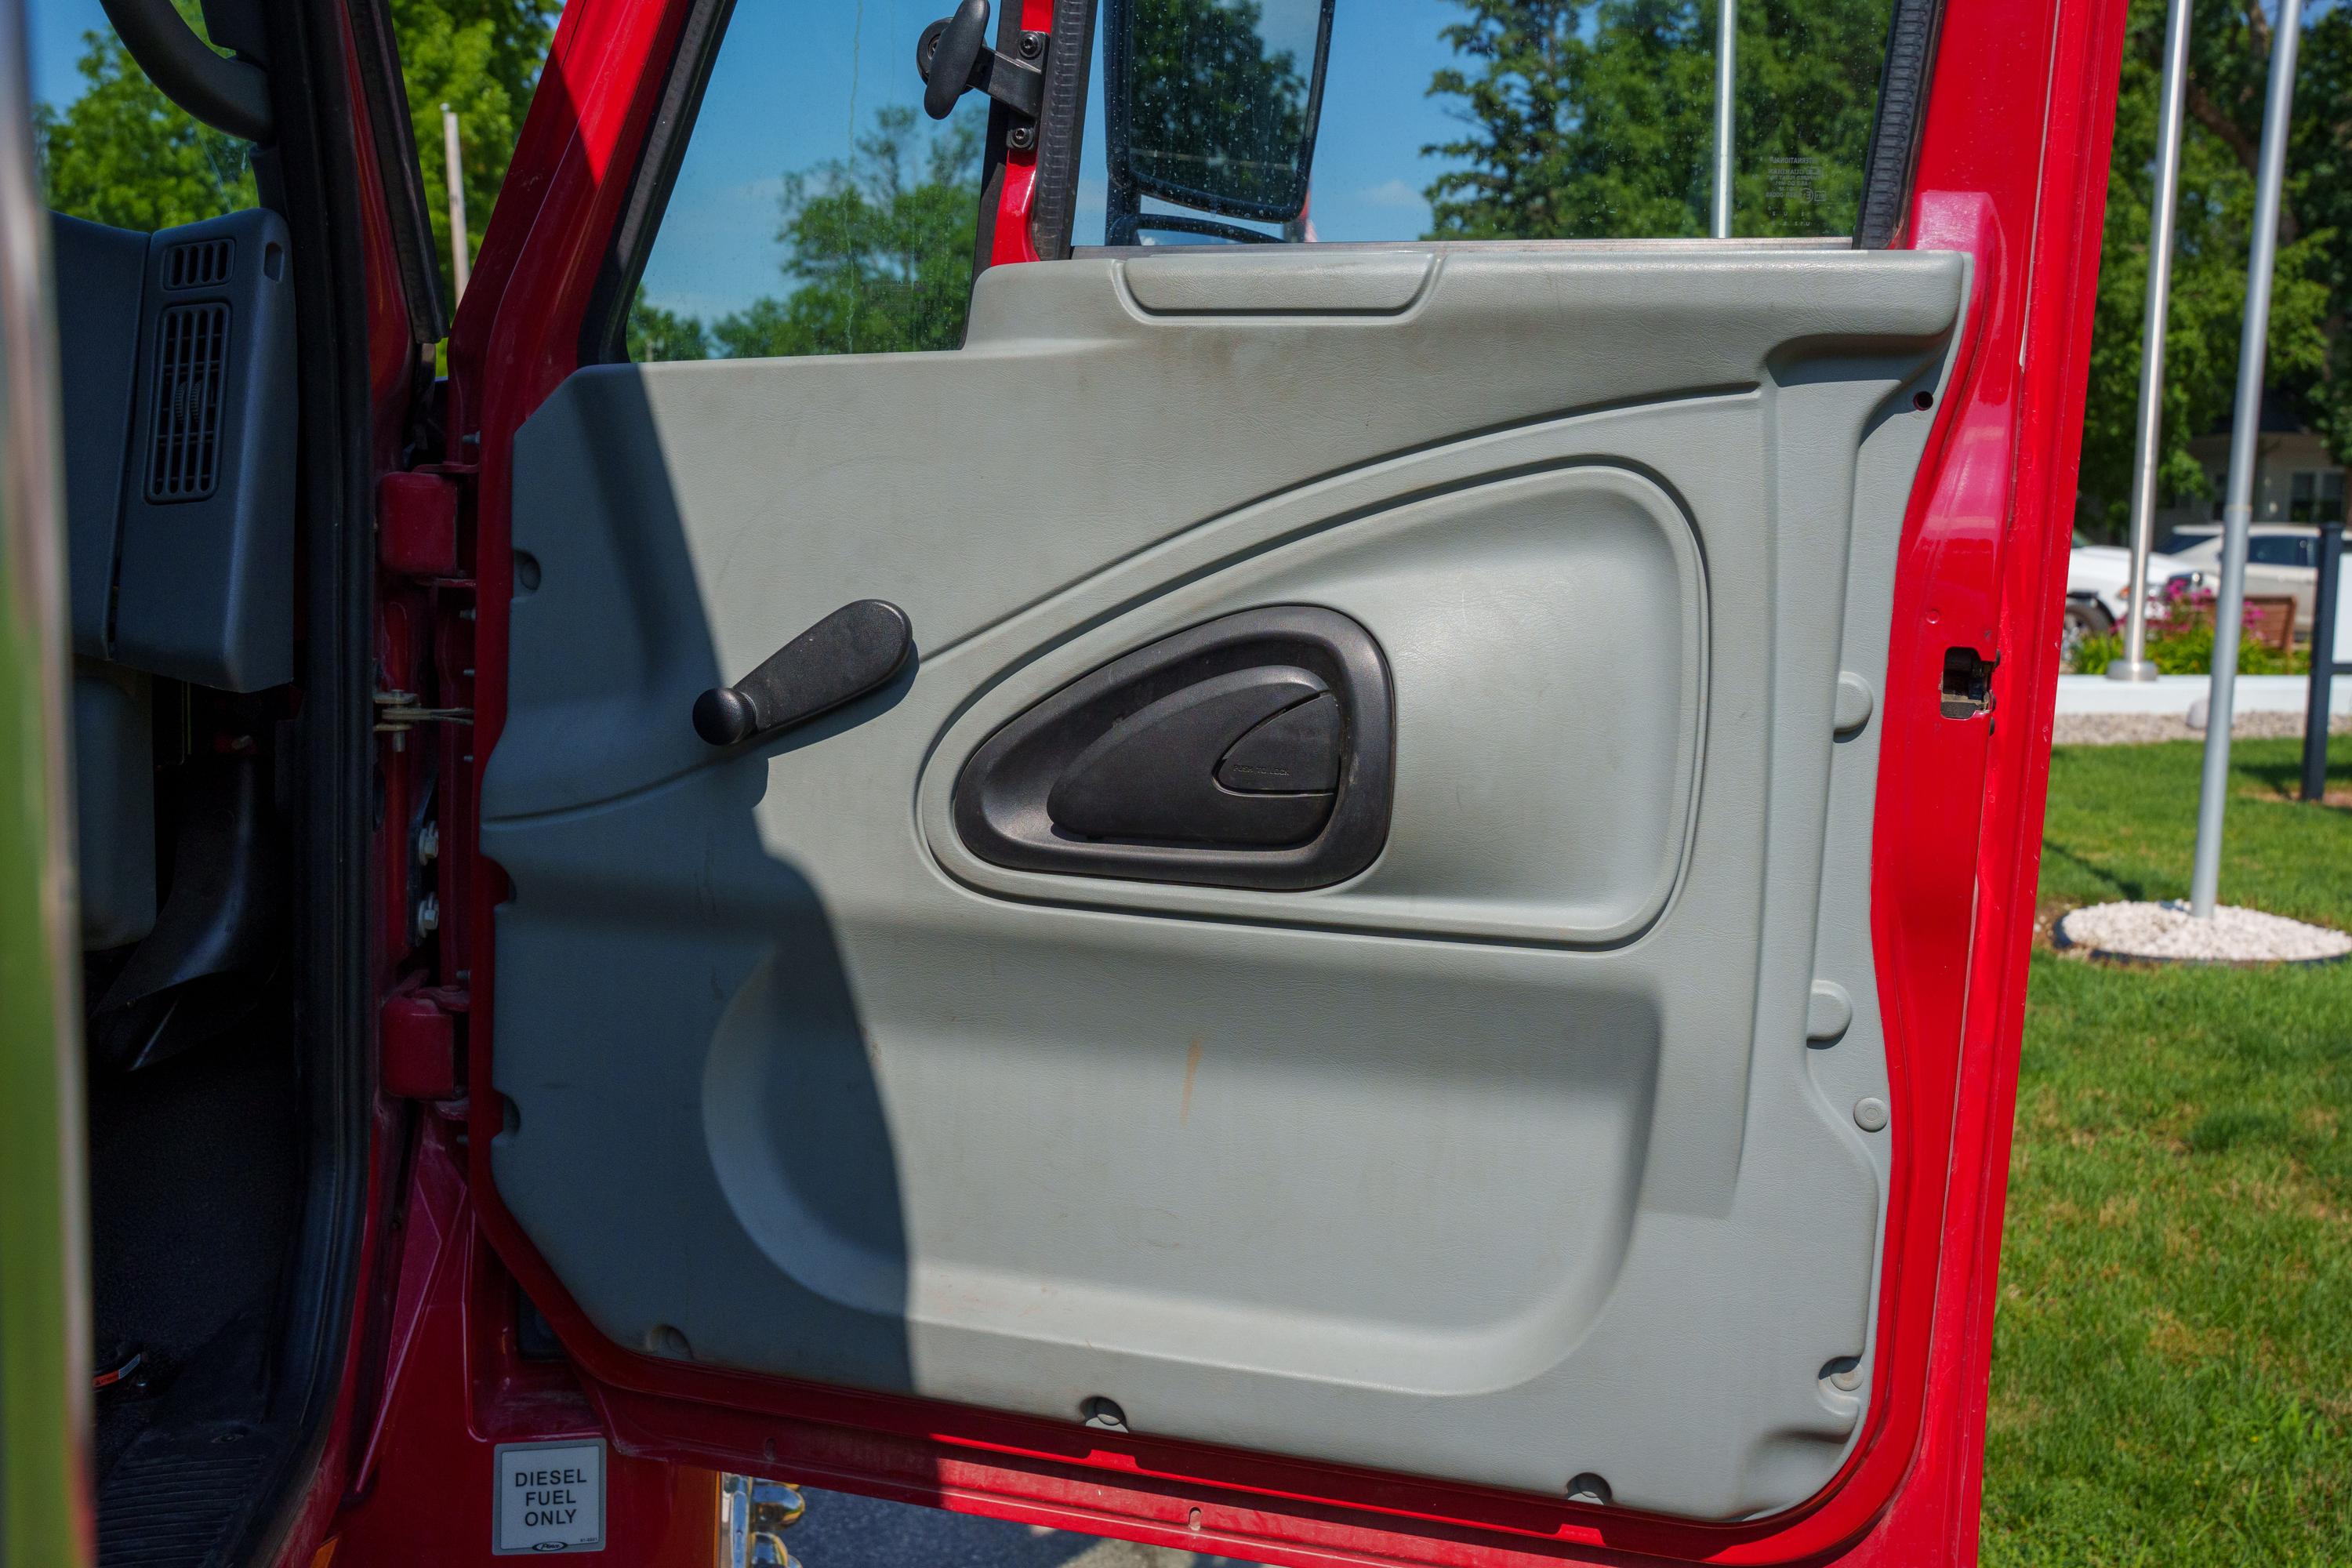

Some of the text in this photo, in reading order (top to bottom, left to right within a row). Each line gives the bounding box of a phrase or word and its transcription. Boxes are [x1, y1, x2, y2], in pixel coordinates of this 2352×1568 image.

[515, 1469, 586, 1487] DIESEL
[526, 1490, 576, 1506] FUEL
[524, 1509, 577, 1526] ONLY
